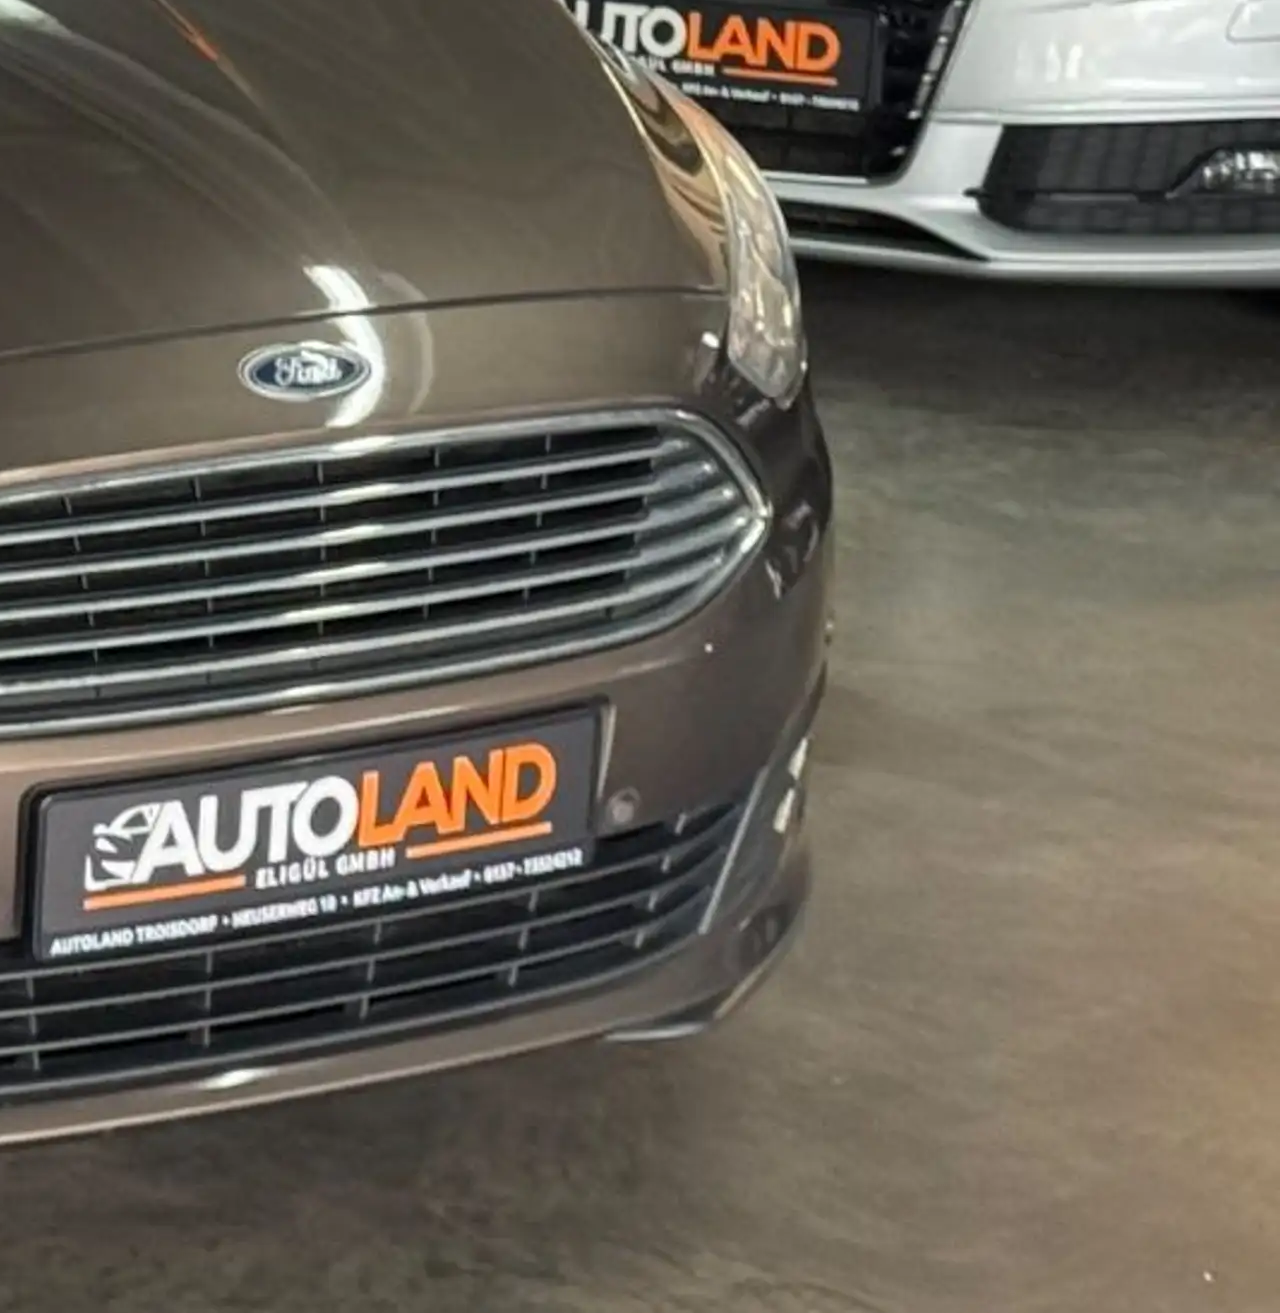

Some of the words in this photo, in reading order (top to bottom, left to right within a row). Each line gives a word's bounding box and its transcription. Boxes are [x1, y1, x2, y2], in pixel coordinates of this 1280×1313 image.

[129, 741, 557, 885] AUTOLAND
[254, 856, 329, 889] ELIGÜL
[335, 847, 397, 876] GMBH
[49, 926, 134, 958] AUTOLAND
[135, 915, 218, 944] TROISDORF
